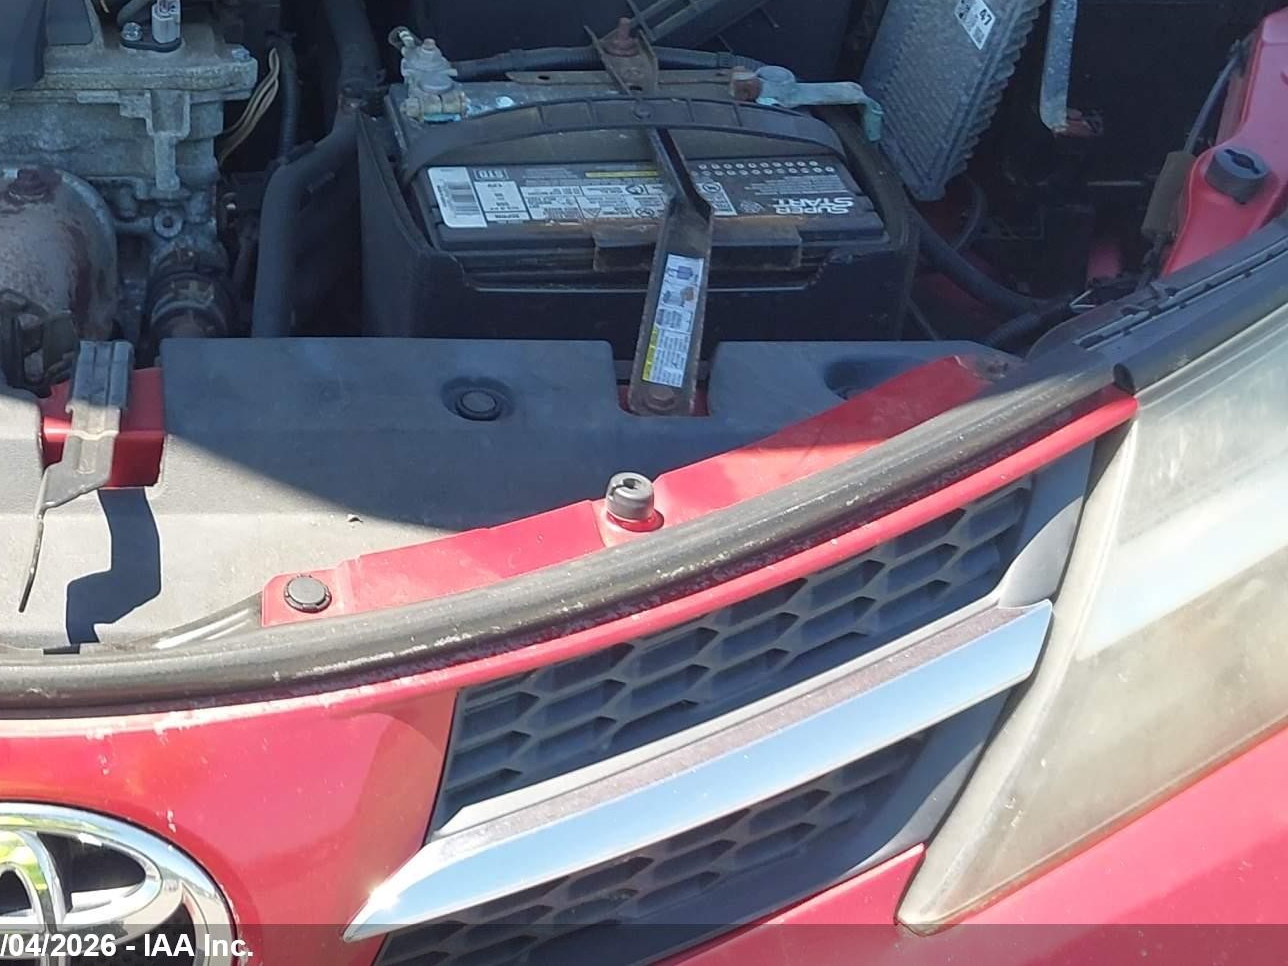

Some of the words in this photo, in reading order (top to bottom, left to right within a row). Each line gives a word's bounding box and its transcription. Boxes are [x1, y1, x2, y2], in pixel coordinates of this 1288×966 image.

[979, 9, 993, 25] 47
[772, 197, 854, 208] START
[775, 206, 849, 215] SUPER
